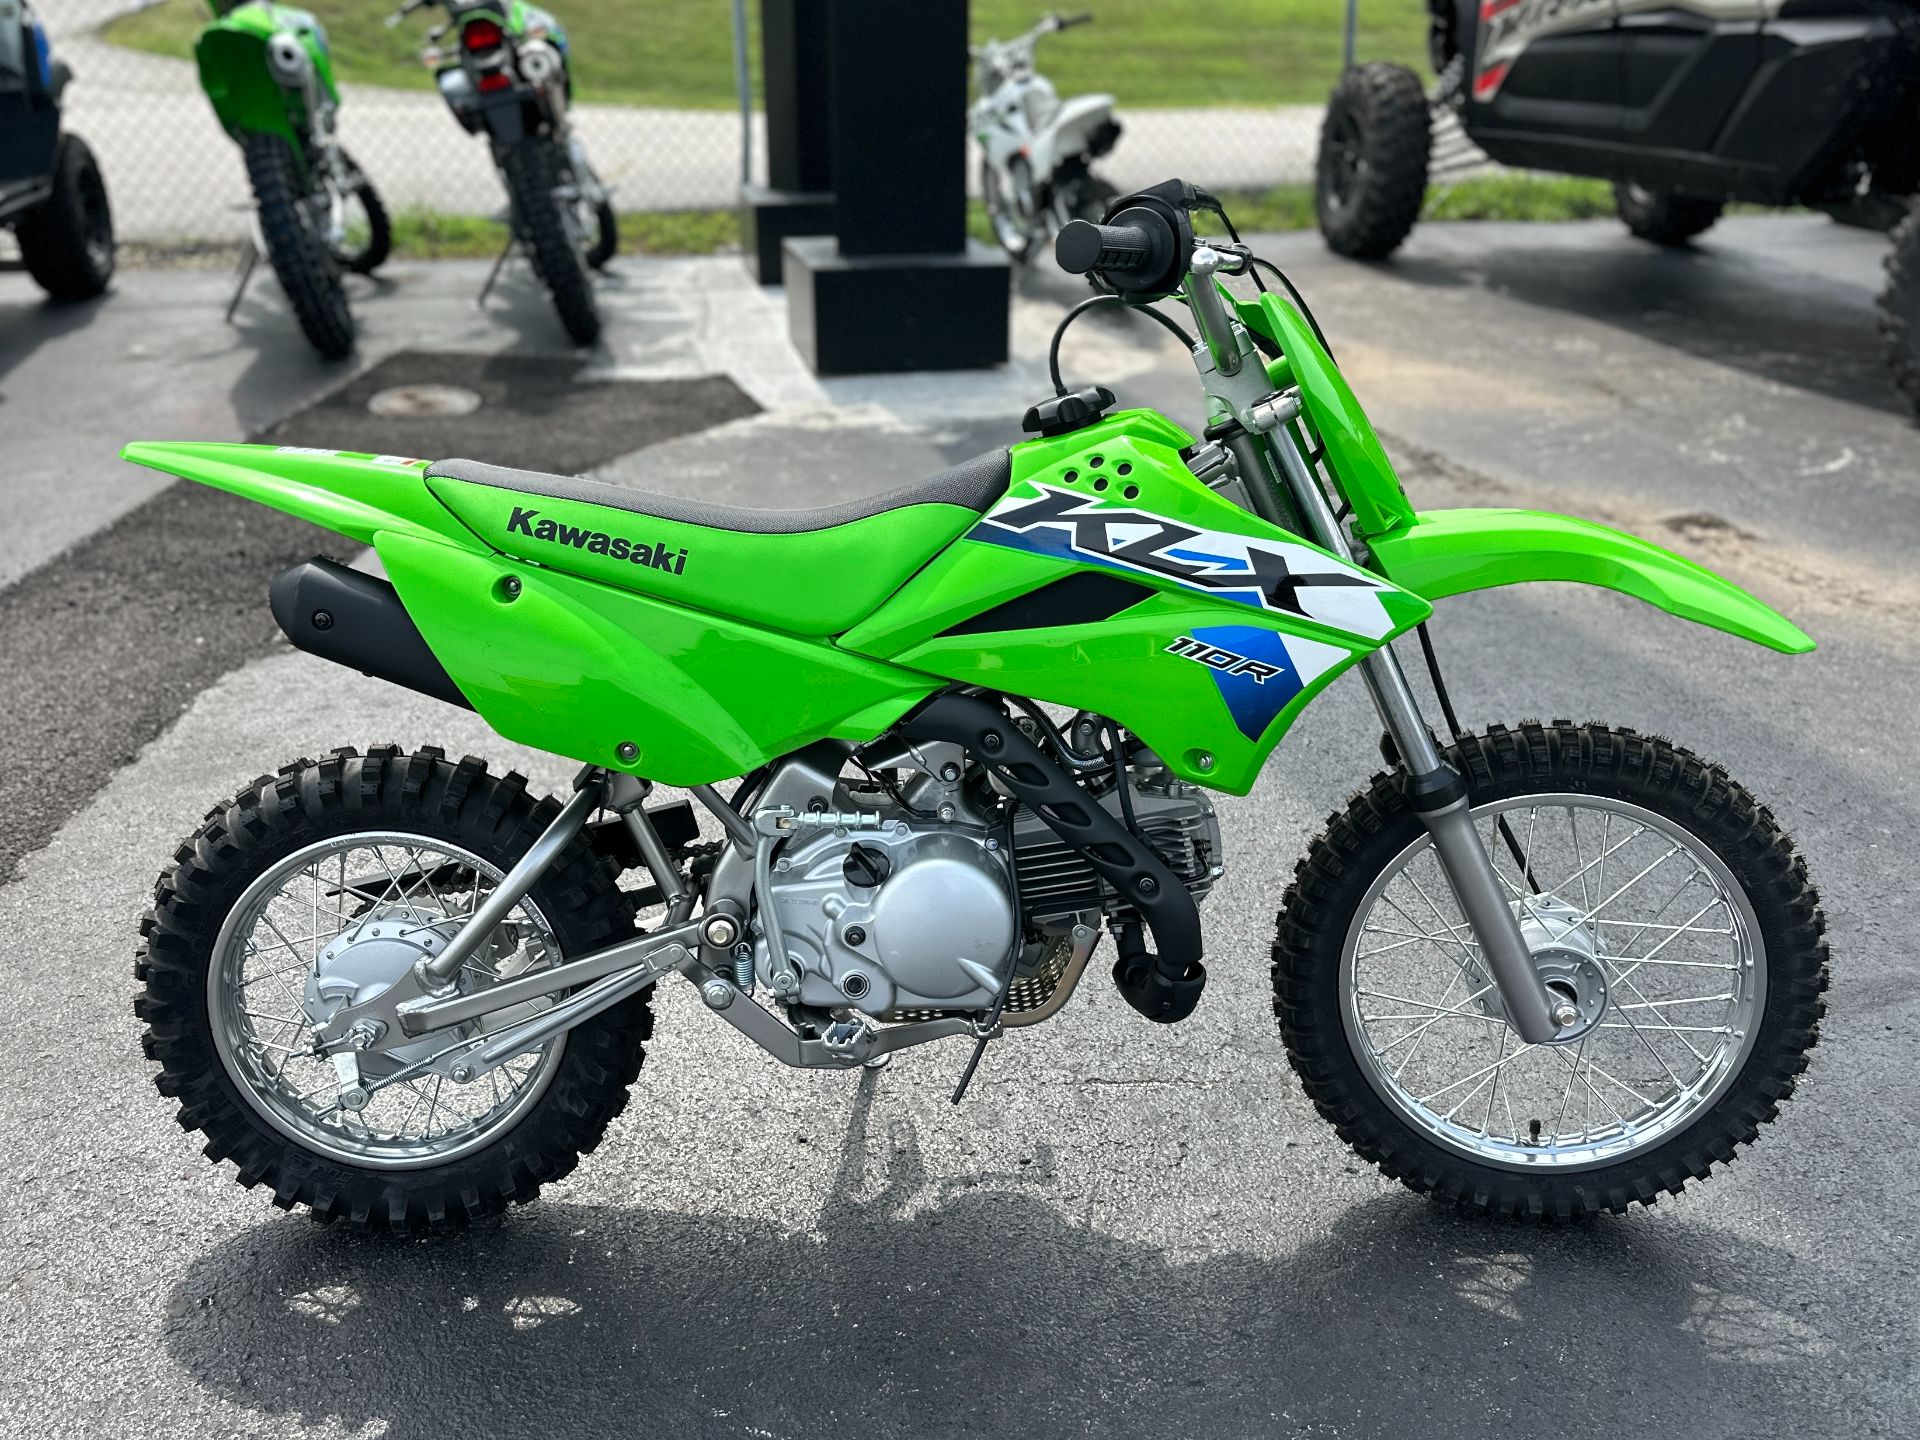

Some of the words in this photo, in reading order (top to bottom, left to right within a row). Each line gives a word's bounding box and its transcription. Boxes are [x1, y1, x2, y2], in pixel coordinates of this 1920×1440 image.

[506, 506, 689, 576] Kawasaki
[987, 486, 1382, 620] KLX
[1163, 636, 1285, 685] 110R
